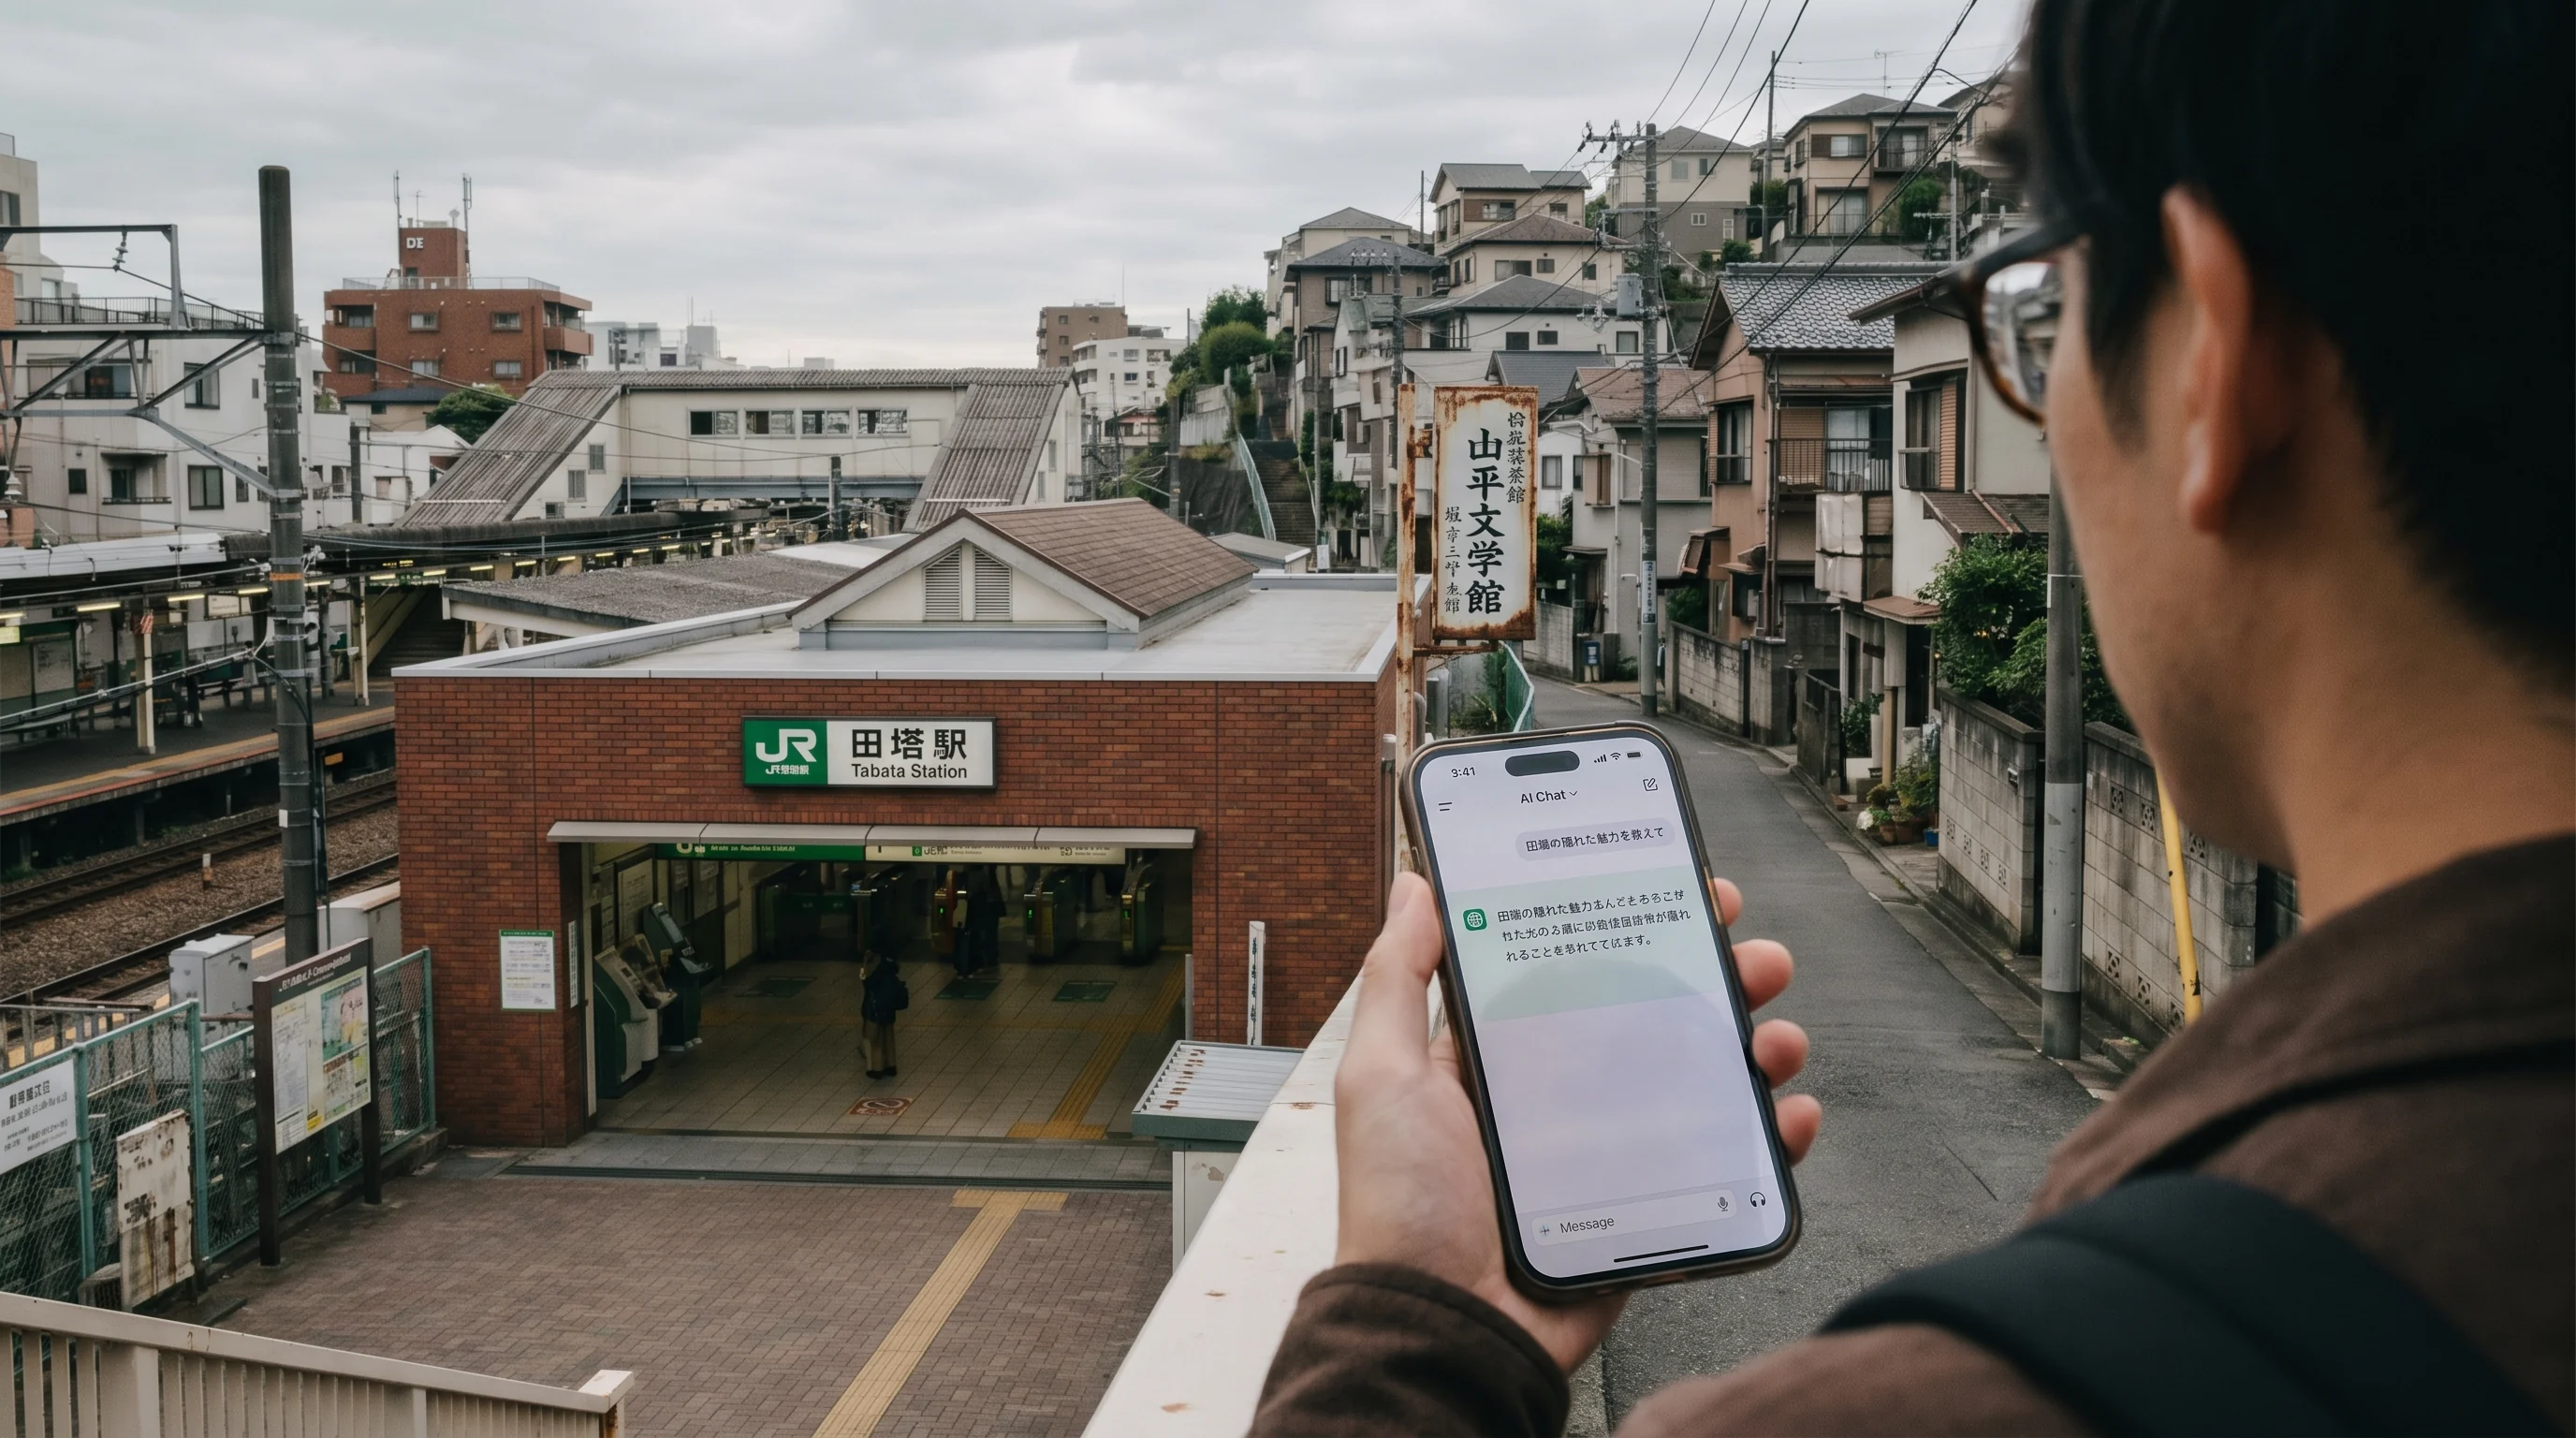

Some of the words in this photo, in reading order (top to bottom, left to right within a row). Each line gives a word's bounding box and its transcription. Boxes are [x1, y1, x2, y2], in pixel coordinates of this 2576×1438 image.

[406, 237, 424, 249] DE
[1465, 427, 1505, 614] 山平文学館
[755, 728, 817, 763] JR
[852, 727, 968, 760] 田塔駅
[852, 763, 906, 778] Tabata
[911, 763, 967, 779] Station
[1520, 793, 1533, 804] AI
[1536, 790, 1567, 802] Chat
[1559, 1217, 1615, 1234] Message
